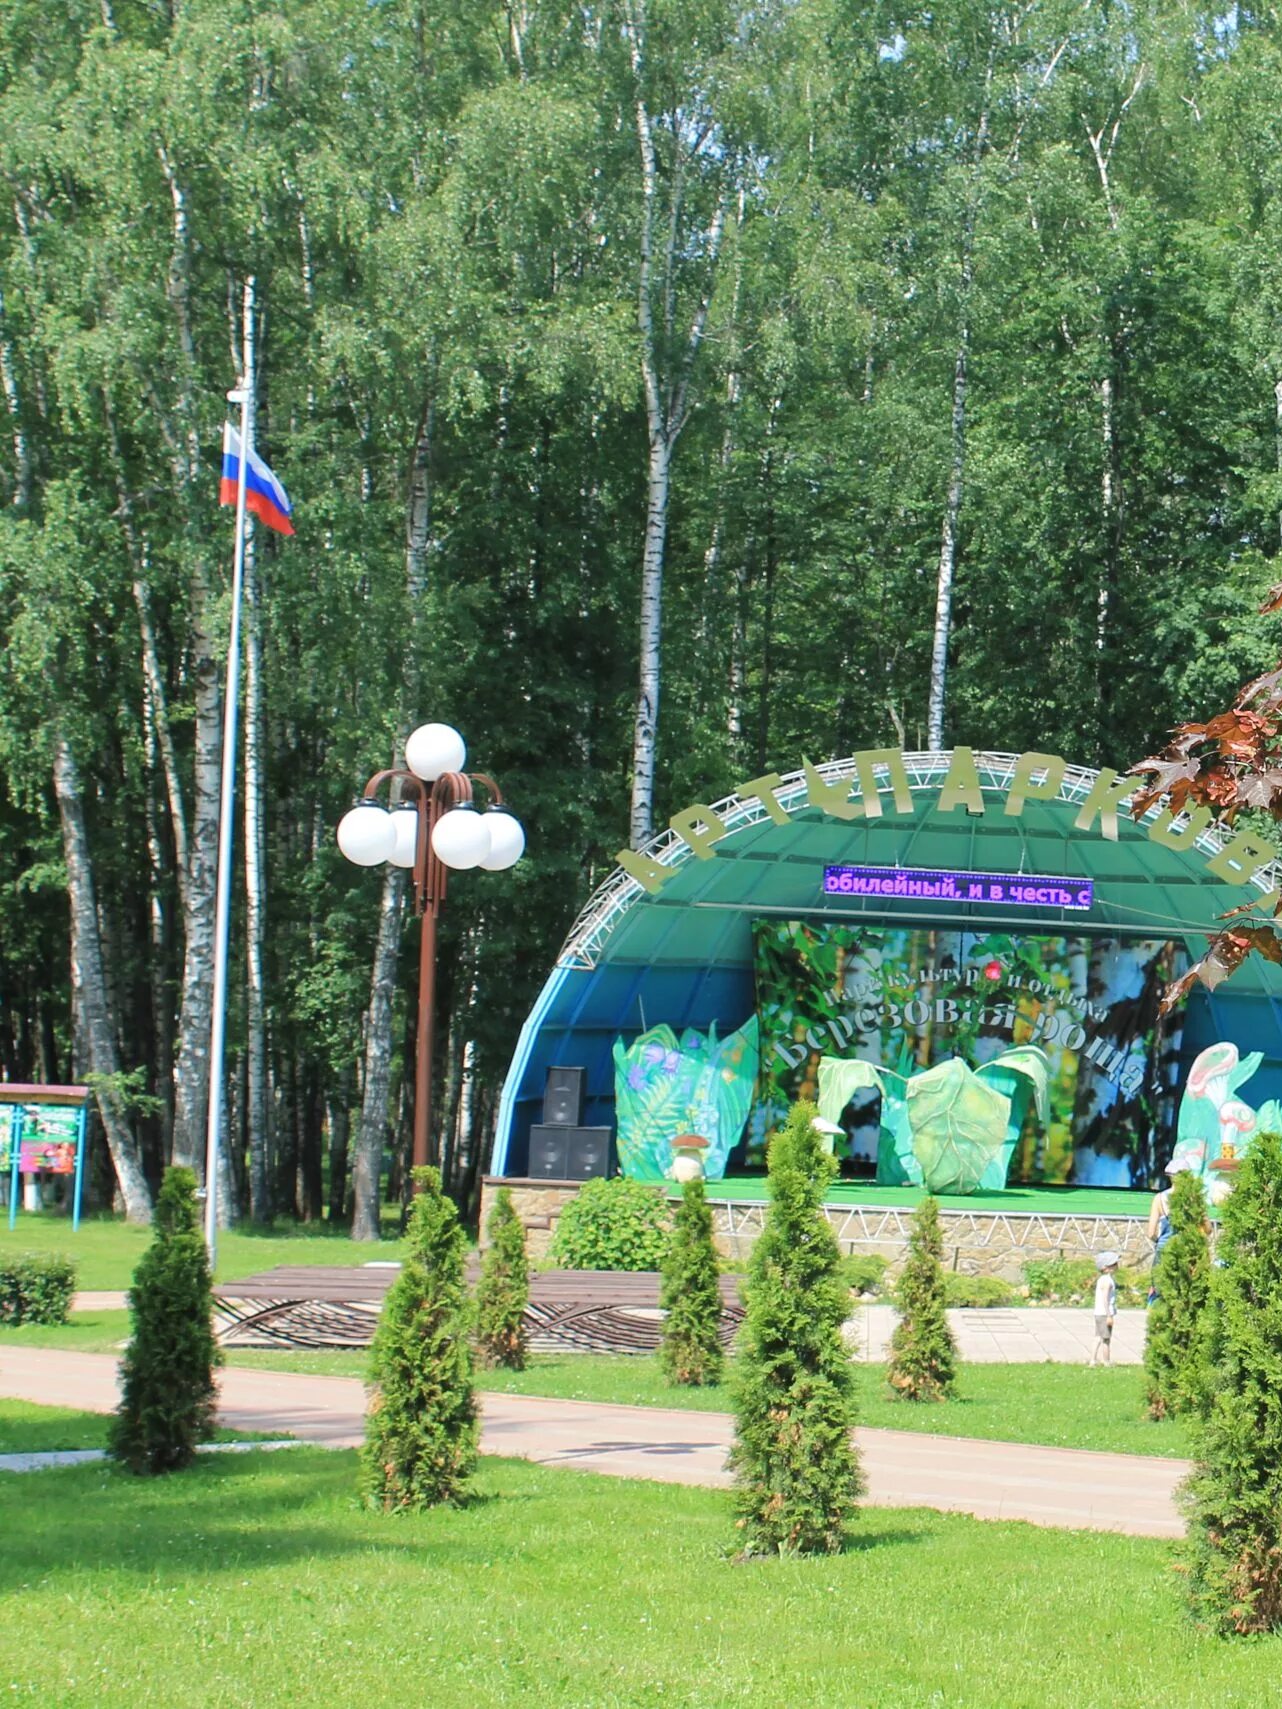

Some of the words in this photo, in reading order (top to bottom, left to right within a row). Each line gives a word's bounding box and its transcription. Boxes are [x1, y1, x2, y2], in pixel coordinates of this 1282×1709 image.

[969, 883, 983, 899] и
[990, 886, 1004, 900] в
[1009, 887, 1072, 903] честь
[887, 966, 979, 989] культур
[1007, 974, 1022, 989] и
